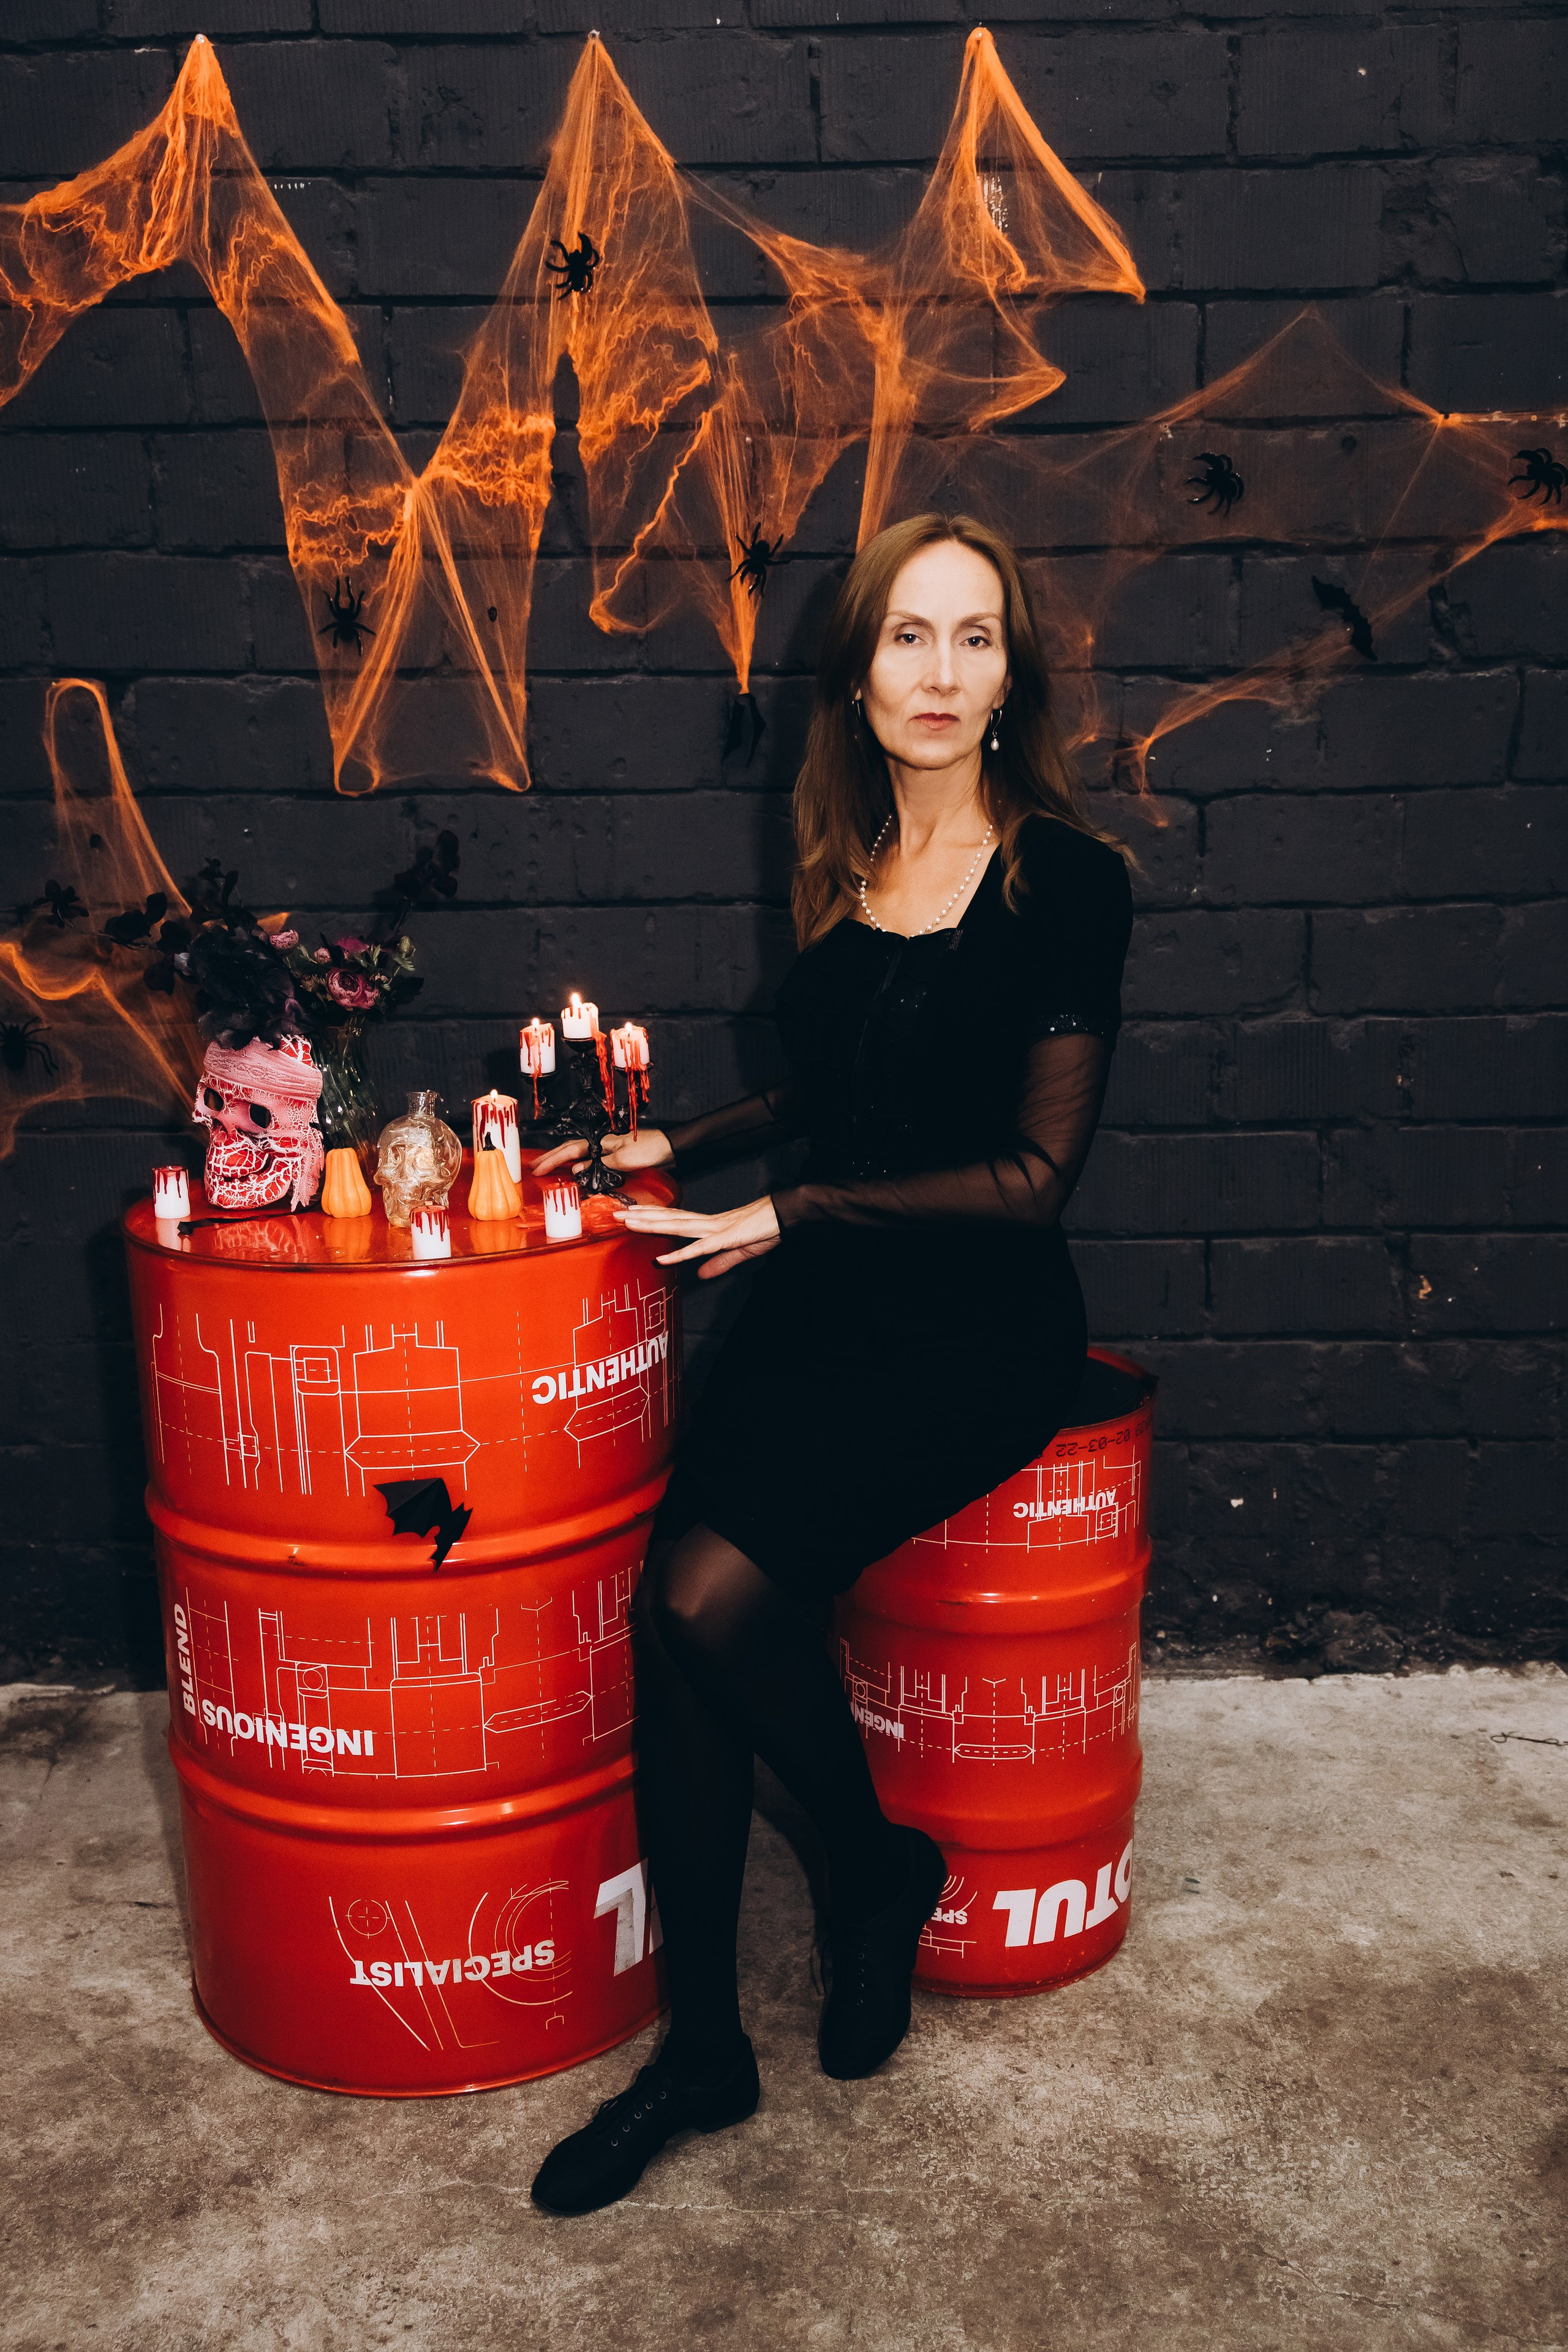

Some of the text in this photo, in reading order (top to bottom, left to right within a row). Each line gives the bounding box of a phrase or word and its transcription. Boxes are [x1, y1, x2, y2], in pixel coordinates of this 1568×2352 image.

[531, 1330, 669, 1404] AUTHENTIC
[1056, 1429, 1130, 1457] 02-03-22
[1013, 1488, 1117, 1518] AUTHENTIC
[175, 1604, 196, 1716] BLEND
[202, 1699, 374, 1756] INGENIOUS
[594, 1857, 664, 1977] L
[930, 1907, 968, 1925] SPE
[350, 1940, 555, 1987] SPECIALIST
